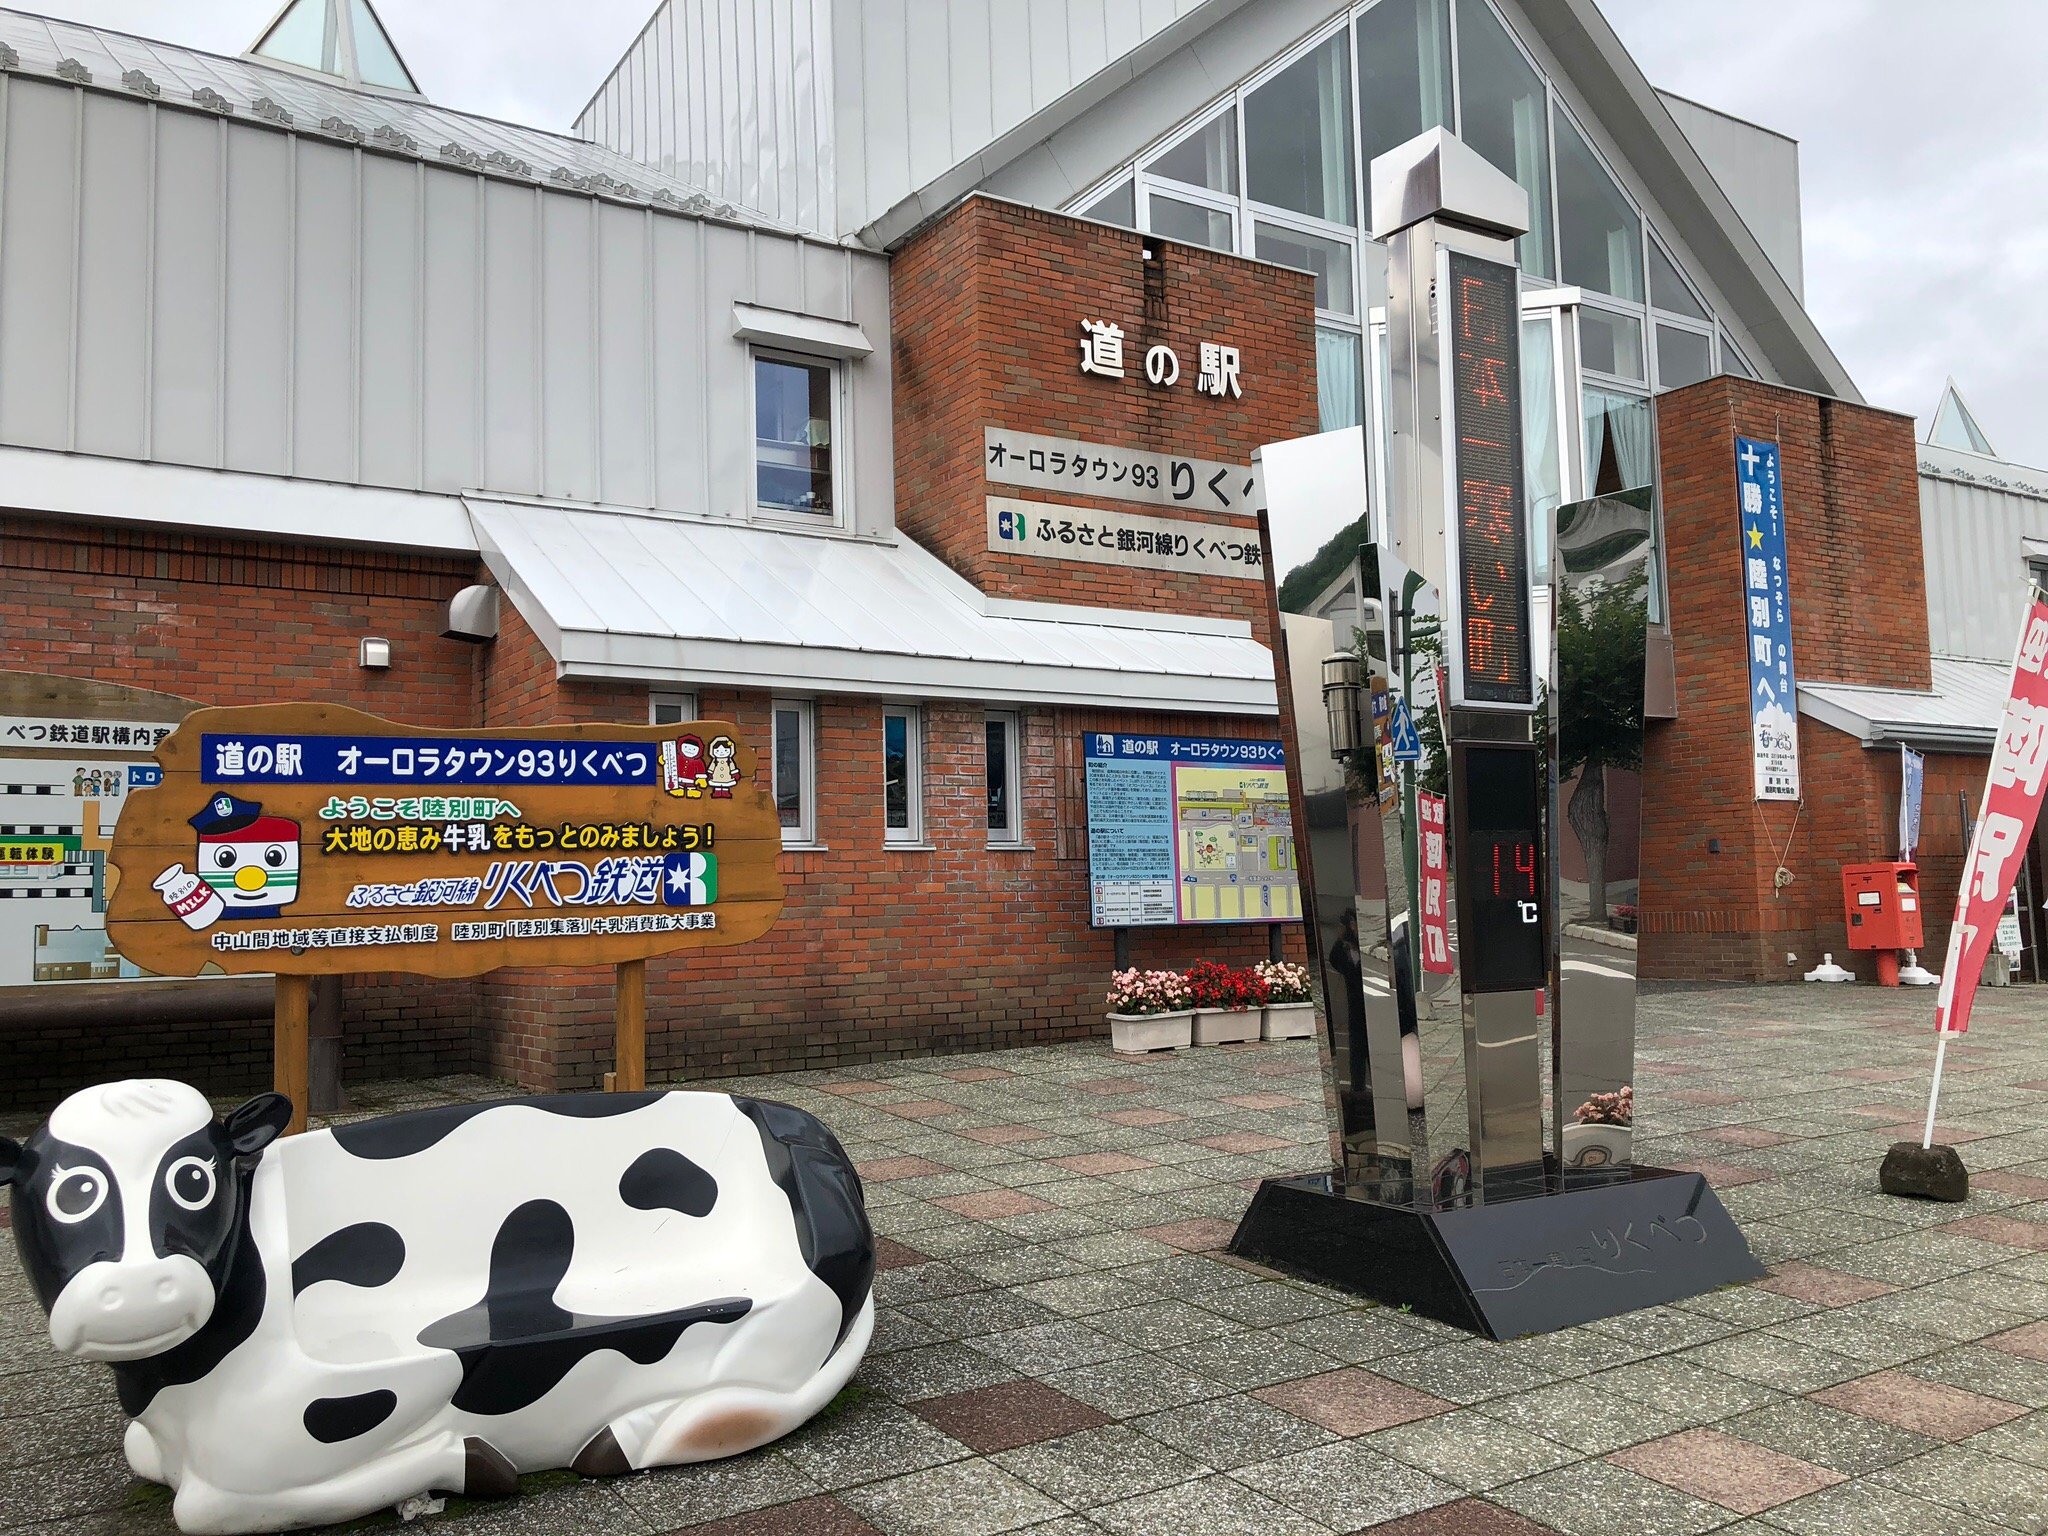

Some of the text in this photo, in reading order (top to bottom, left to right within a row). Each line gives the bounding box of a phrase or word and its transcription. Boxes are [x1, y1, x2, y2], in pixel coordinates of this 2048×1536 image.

[1080, 317, 1242, 399] 道の駅
[988, 442, 1254, 507] オーロラタウン93りく
[215, 741, 647, 777] 道の駅 オーロラタウン93りくべつ
[1121, 739, 1159, 755] 道の駅
[132, 770, 164, 782] トロ
[320, 796, 521, 819] ようこそ陸別町へ
[325, 823, 714, 852] 大地の恵み牛乳をもっとのみましょう！
[1493, 844, 1535, 896] 14
[168, 880, 195, 901] 陸別の
[176, 886, 211, 914] MILK
[347, 877, 480, 907] ふるさと銀河線
[213, 913, 715, 950] 中山間地域等直接支払制度 陸別町「陸別集落」牛乳消費拡大事業
[1590, 1214, 1707, 1259] りくべつ
